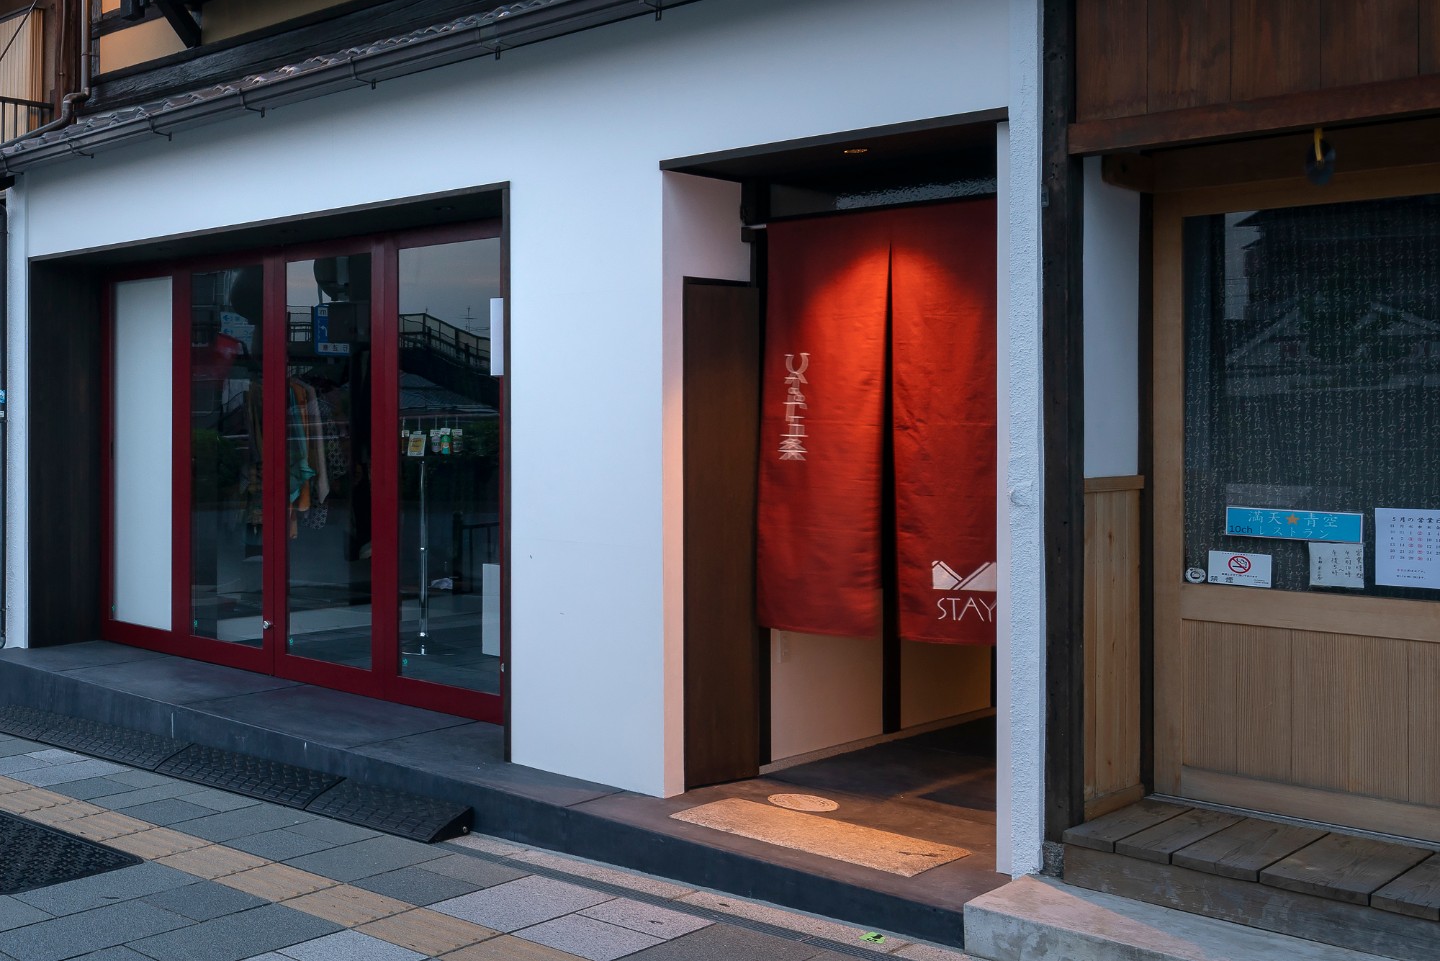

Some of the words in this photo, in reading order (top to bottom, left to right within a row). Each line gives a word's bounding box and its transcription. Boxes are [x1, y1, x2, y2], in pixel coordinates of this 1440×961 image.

[1229, 525, 1253, 534] 10ch
[1259, 526, 1329, 539] レストラン
[937, 596, 997, 623] STAY
